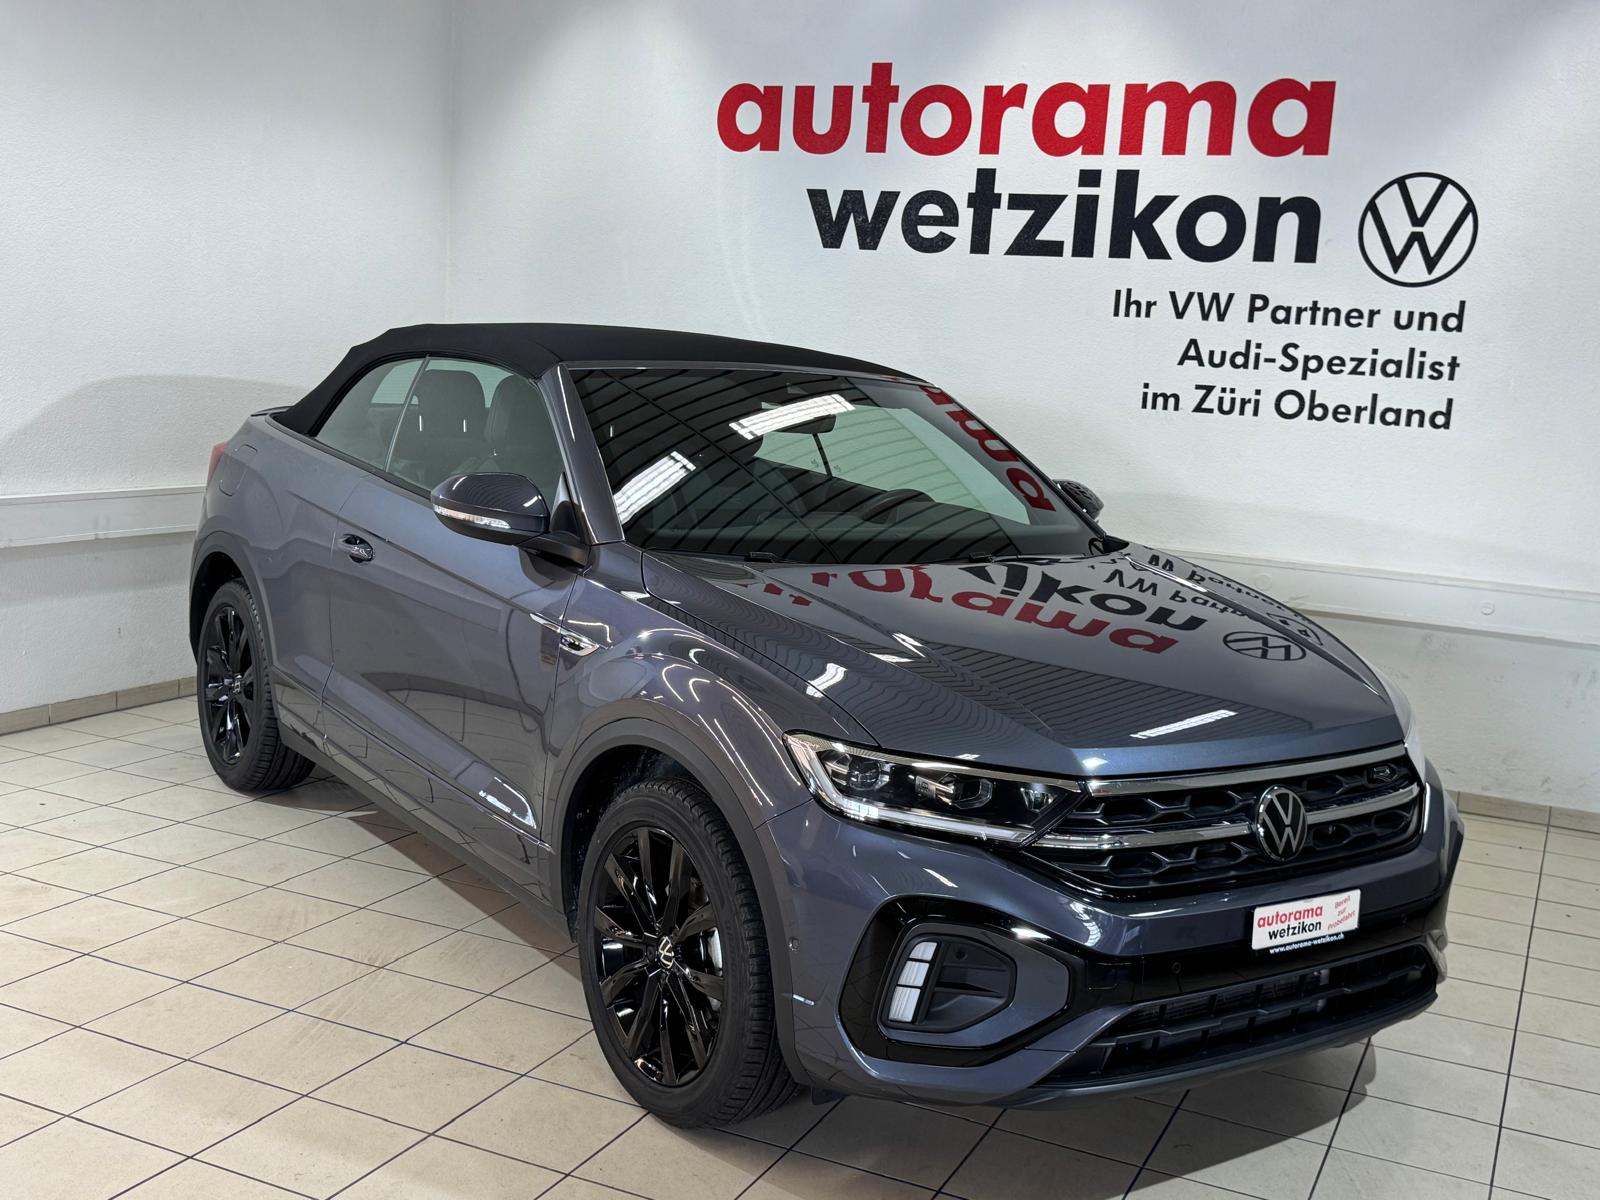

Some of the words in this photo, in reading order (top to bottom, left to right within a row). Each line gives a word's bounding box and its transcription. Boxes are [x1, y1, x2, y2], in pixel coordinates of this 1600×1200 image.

[717, 62, 1336, 158] autorama
[806, 167, 1321, 264] wetzikon
[1112, 287, 1158, 319] Ihr
[1168, 290, 1236, 323] VW
[1246, 293, 1381, 329] Partner
[1393, 299, 1467, 333] und
[1176, 337, 1461, 382] Audi-Spezialist
[1140, 381, 1181, 412] im
[1191, 383, 1263, 418] Züri
[1273, 388, 1455, 431] Oberland
[1257, 905, 1324, 929] autorama
[1268, 920, 1323, 941] wetzikon
[1269, 932, 1345, 955] www.autorama-wetzikon.ch
